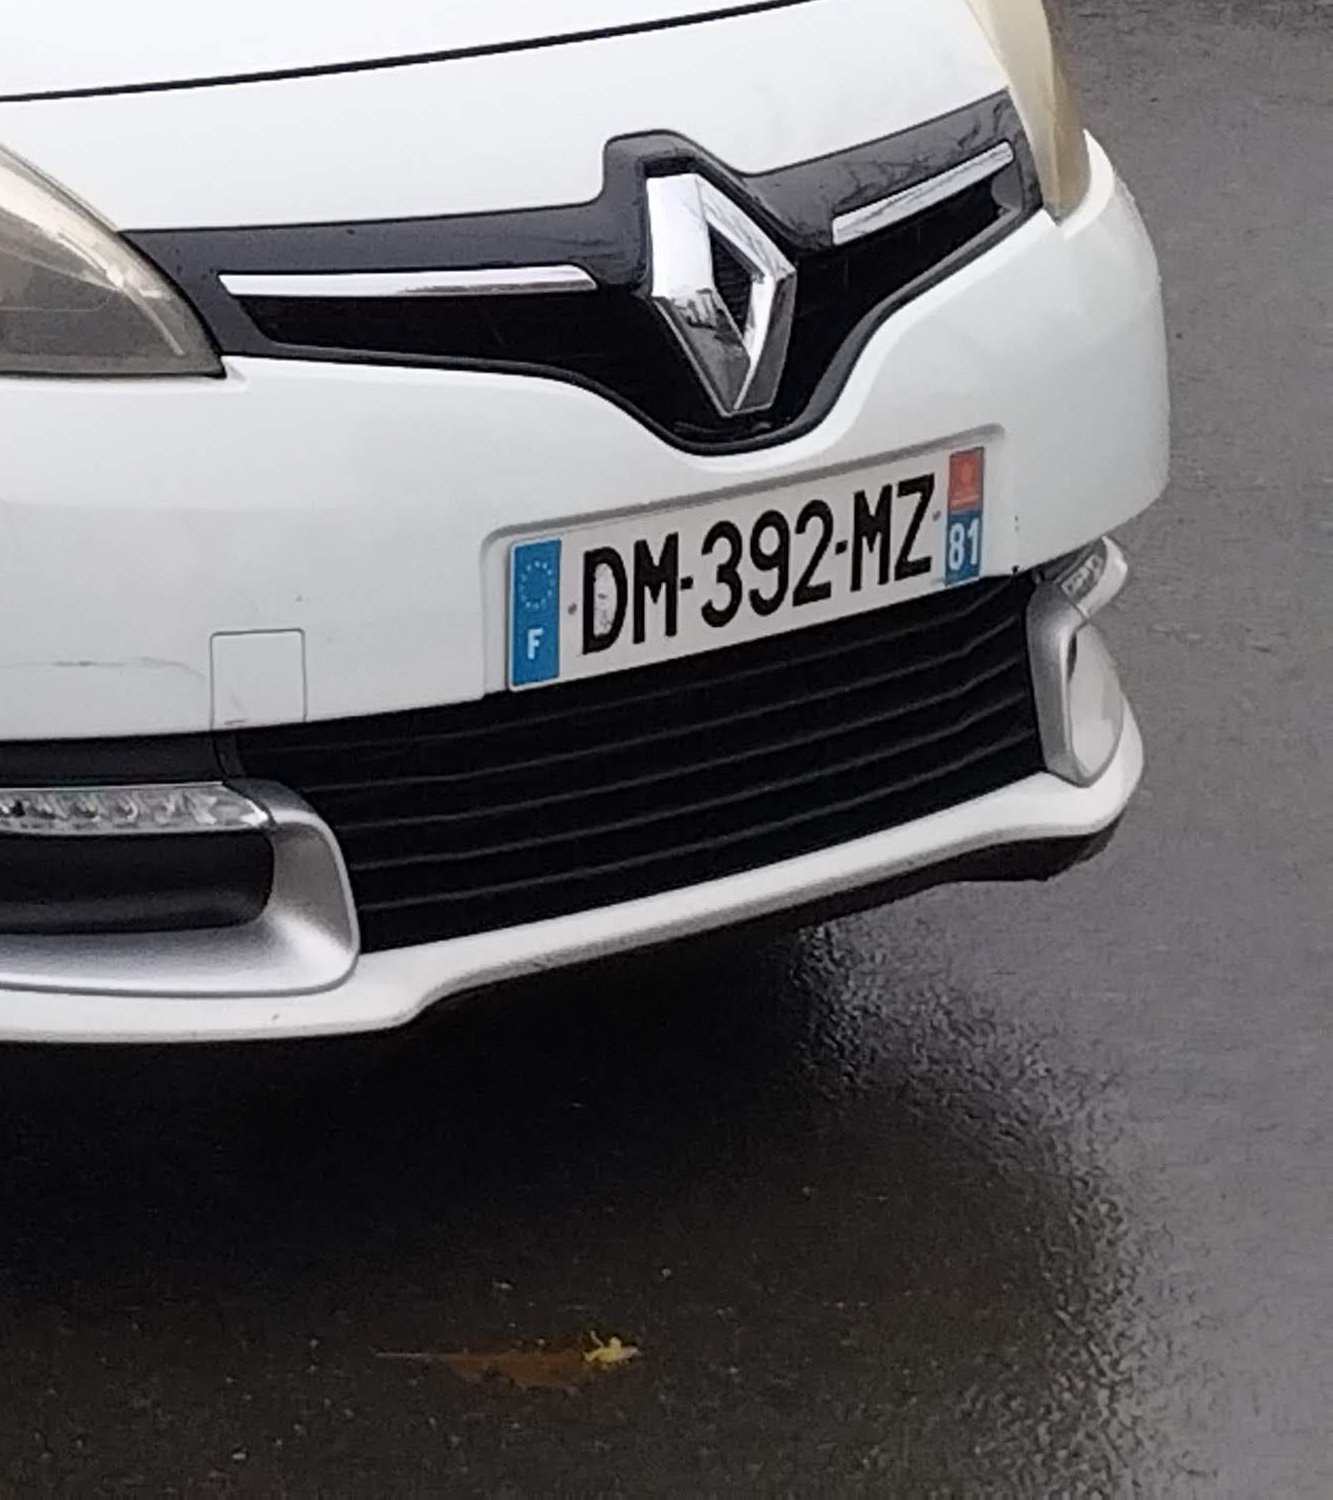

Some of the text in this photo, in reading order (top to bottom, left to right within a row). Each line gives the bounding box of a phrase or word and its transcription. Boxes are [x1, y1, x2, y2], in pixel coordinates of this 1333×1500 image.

[527, 473, 979, 660] F DM-392-MZ 81
